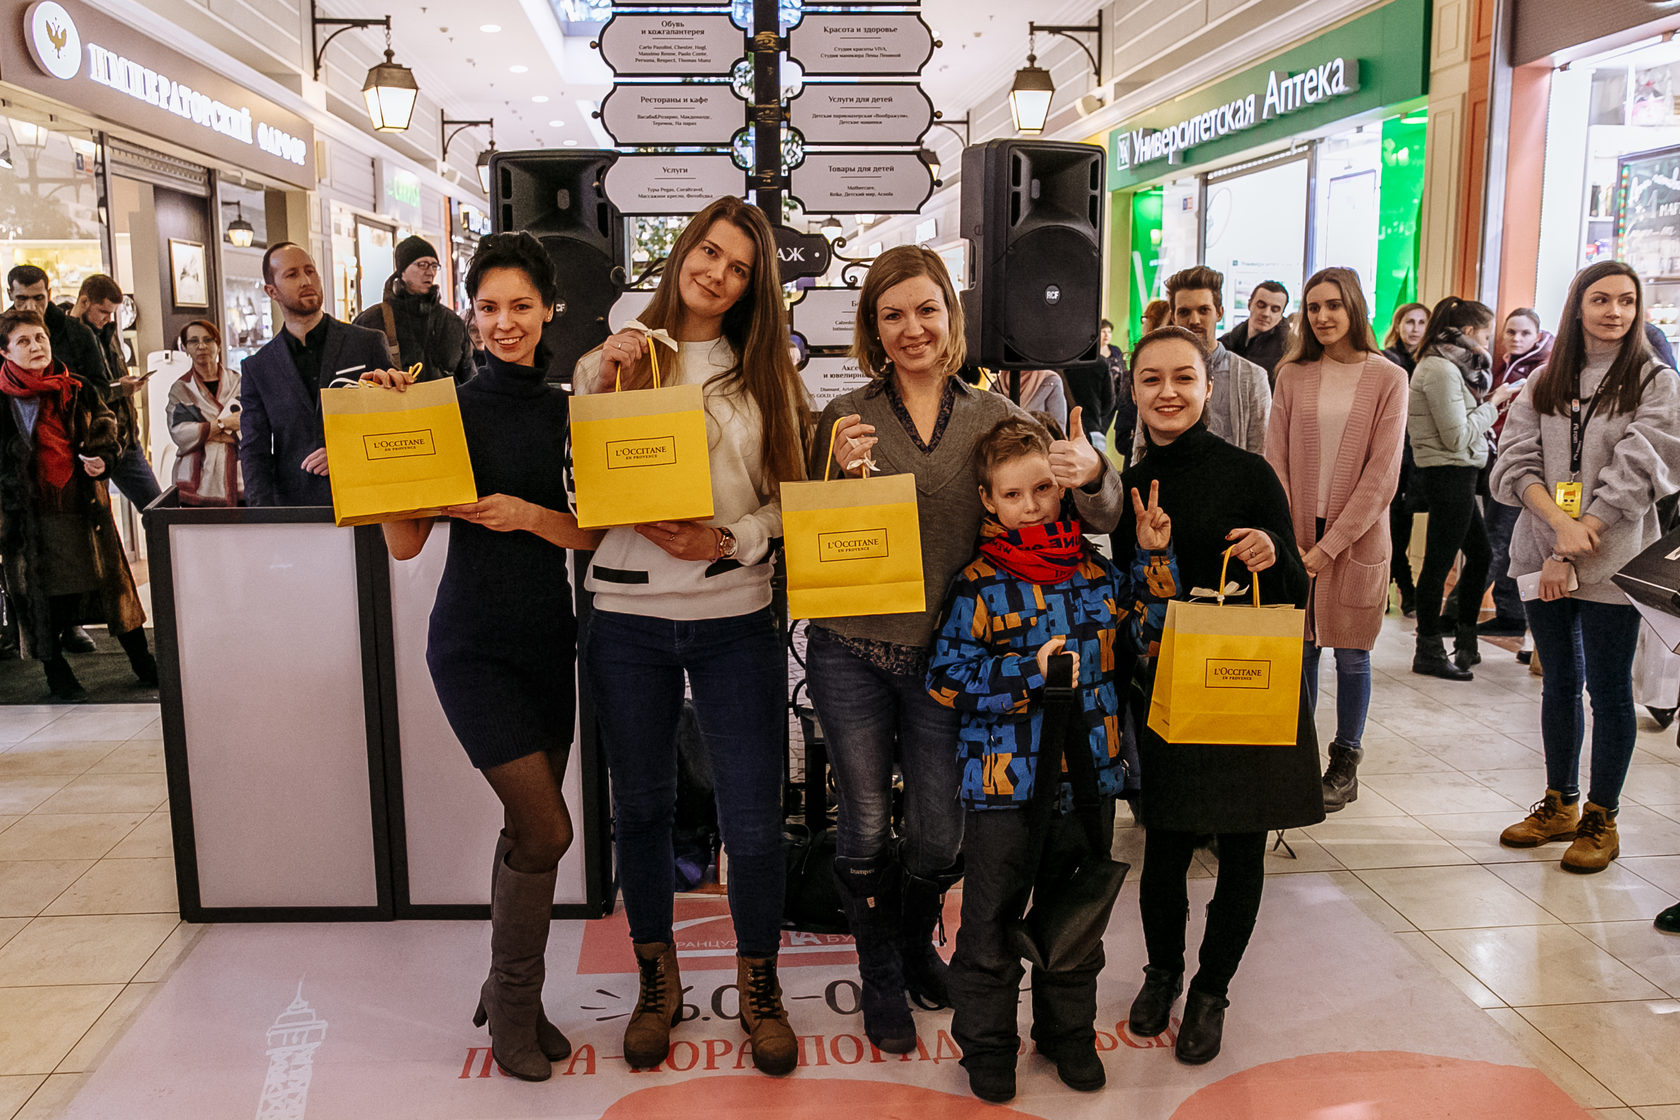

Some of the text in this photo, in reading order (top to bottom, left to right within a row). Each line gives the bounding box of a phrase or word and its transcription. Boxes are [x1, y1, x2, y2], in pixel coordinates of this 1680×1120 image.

[661, 20, 685, 29] Обувь
[823, 26, 855, 34] Красота
[640, 96, 681, 104] Рестораны
[690, 96, 708, 105] кафе
[828, 96, 854, 104] Услуги
[871, 96, 893, 104] детей
[1132, 93, 1256, 166] Университетская
[1262, 57, 1349, 120] Аптека
[828, 166, 856, 174] Товары
[776, 247, 805, 262] АЖ
[373, 438, 425, 449] L'OCCITANE
[615, 446, 667, 457] L'OCCITANE
[827, 538, 880, 549] L'OCCITANE
[1214, 667, 1262, 676] L'OCCITANE
[676, 940, 738, 949] РАНЦУЗ
